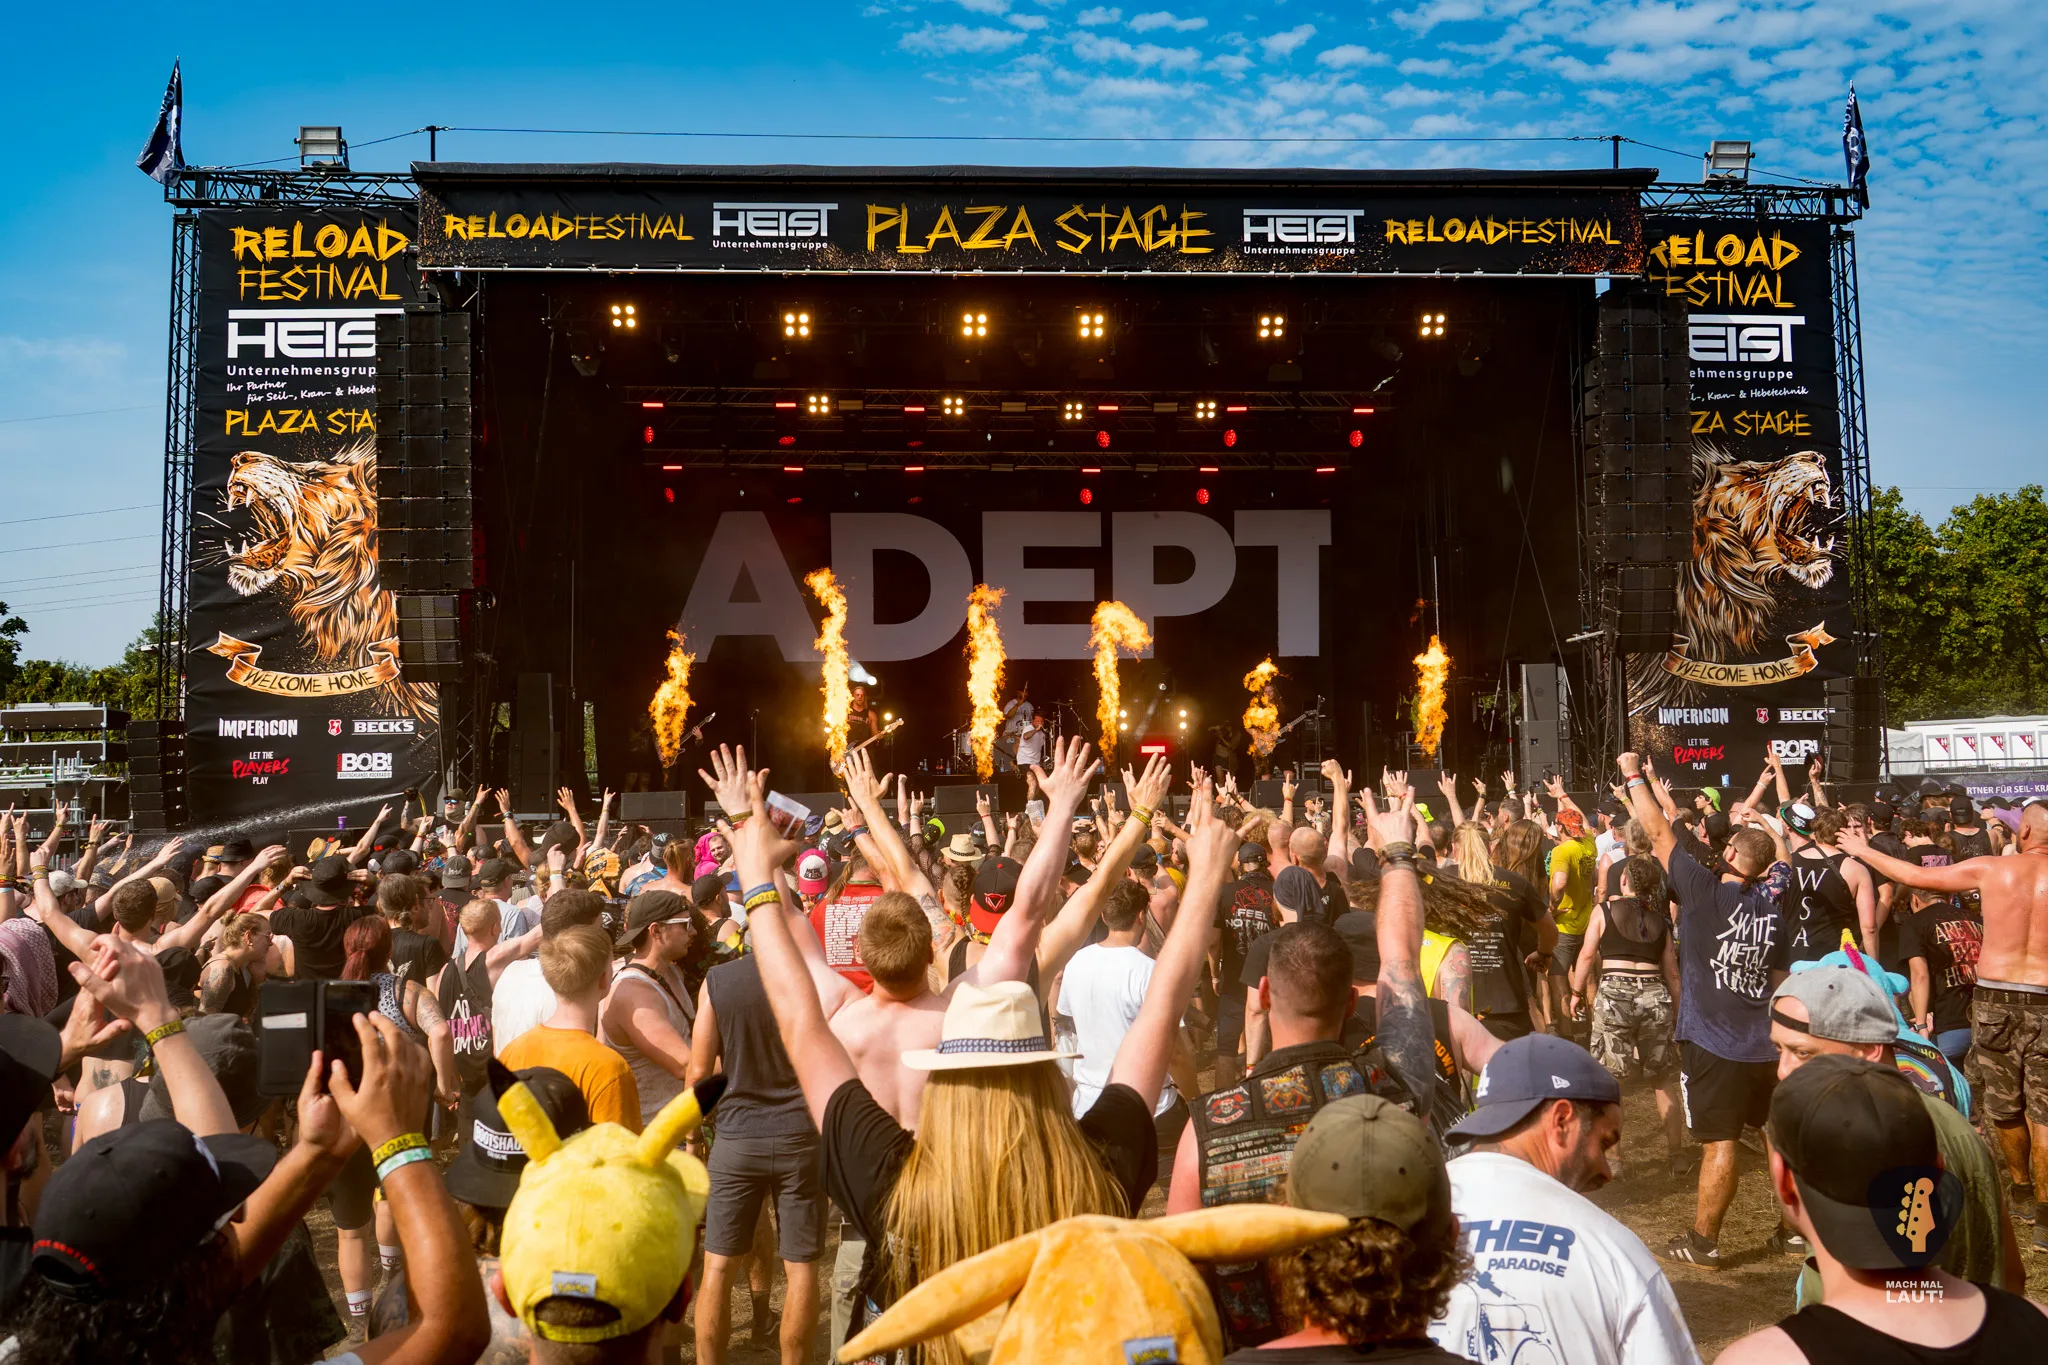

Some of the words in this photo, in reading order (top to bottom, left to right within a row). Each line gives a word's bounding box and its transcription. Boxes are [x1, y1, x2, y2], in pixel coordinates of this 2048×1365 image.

[712, 202, 838, 237] HEIST
[866, 203, 1048, 253] PLAZA
[1053, 203, 1215, 254] STAGE
[1243, 208, 1365, 243] HEIST
[230, 217, 409, 262] RELOAD
[712, 239, 829, 250] Unternehmensgruppe
[1243, 245, 1356, 256] Unternehmensgruppe
[237, 261, 403, 301] FESTIVAL
[227, 309, 404, 358] HEIS
[1688, 314, 1805, 362] EIST
[226, 364, 376, 378] Unternehmensgrup
[1689, 367, 1793, 382] ehmensgruppe
[226, 383, 244, 392] Ihr
[246, 381, 287, 391] Partner
[246, 393, 264, 405] für
[300, 389, 332, 399] Kran-
[335, 387, 344, 396] &
[347, 385, 376, 396] Hebet
[1707, 391, 1736, 400] Kran-
[1738, 389, 1747, 399] &
[1750, 385, 1809, 398] Hebetechnik
[225, 408, 321, 436] PLAZA
[327, 408, 376, 436] STA
[1733, 409, 1813, 437] STAGE
[671, 509, 1332, 663] ADEPT
[1676, 659, 1748, 682] WELCOME
[1753, 661, 1800, 681] HOME
[243, 670, 321, 693] WELCOME
[328, 670, 378, 691] HOME
[1658, 706, 1729, 726] IMPERICON
[1780, 709, 1835, 721] BECK
[218, 718, 298, 739] IMPERICON
[353, 719, 415, 733] BECK'S
[1687, 738, 1698, 746] LET
[1699, 738, 1710, 746] THE
[249, 751, 261, 760] LET
[262, 751, 274, 760] THE
[341, 752, 393, 771] BOB!
[1673, 745, 1725, 764] PLAYERS
[232, 757, 291, 779] PLAYERS
[1692, 762, 1707, 770] PLAY
[252, 776, 269, 785] PLAY
[1966, 786, 1994, 795] RTNER
[1996, 784, 2012, 794] FÜR
[1225, 918, 1270, 931] NOTHIN
[1238, 908, 1269, 921] FEEL
[1715, 902, 1778, 946] SKATE
[1717, 940, 1770, 974] METAL
[475, 1125, 521, 1151] BOOTSHAU
[1459, 1220, 1576, 1261] THER
[1488, 1257, 1567, 1278] PARADISE
